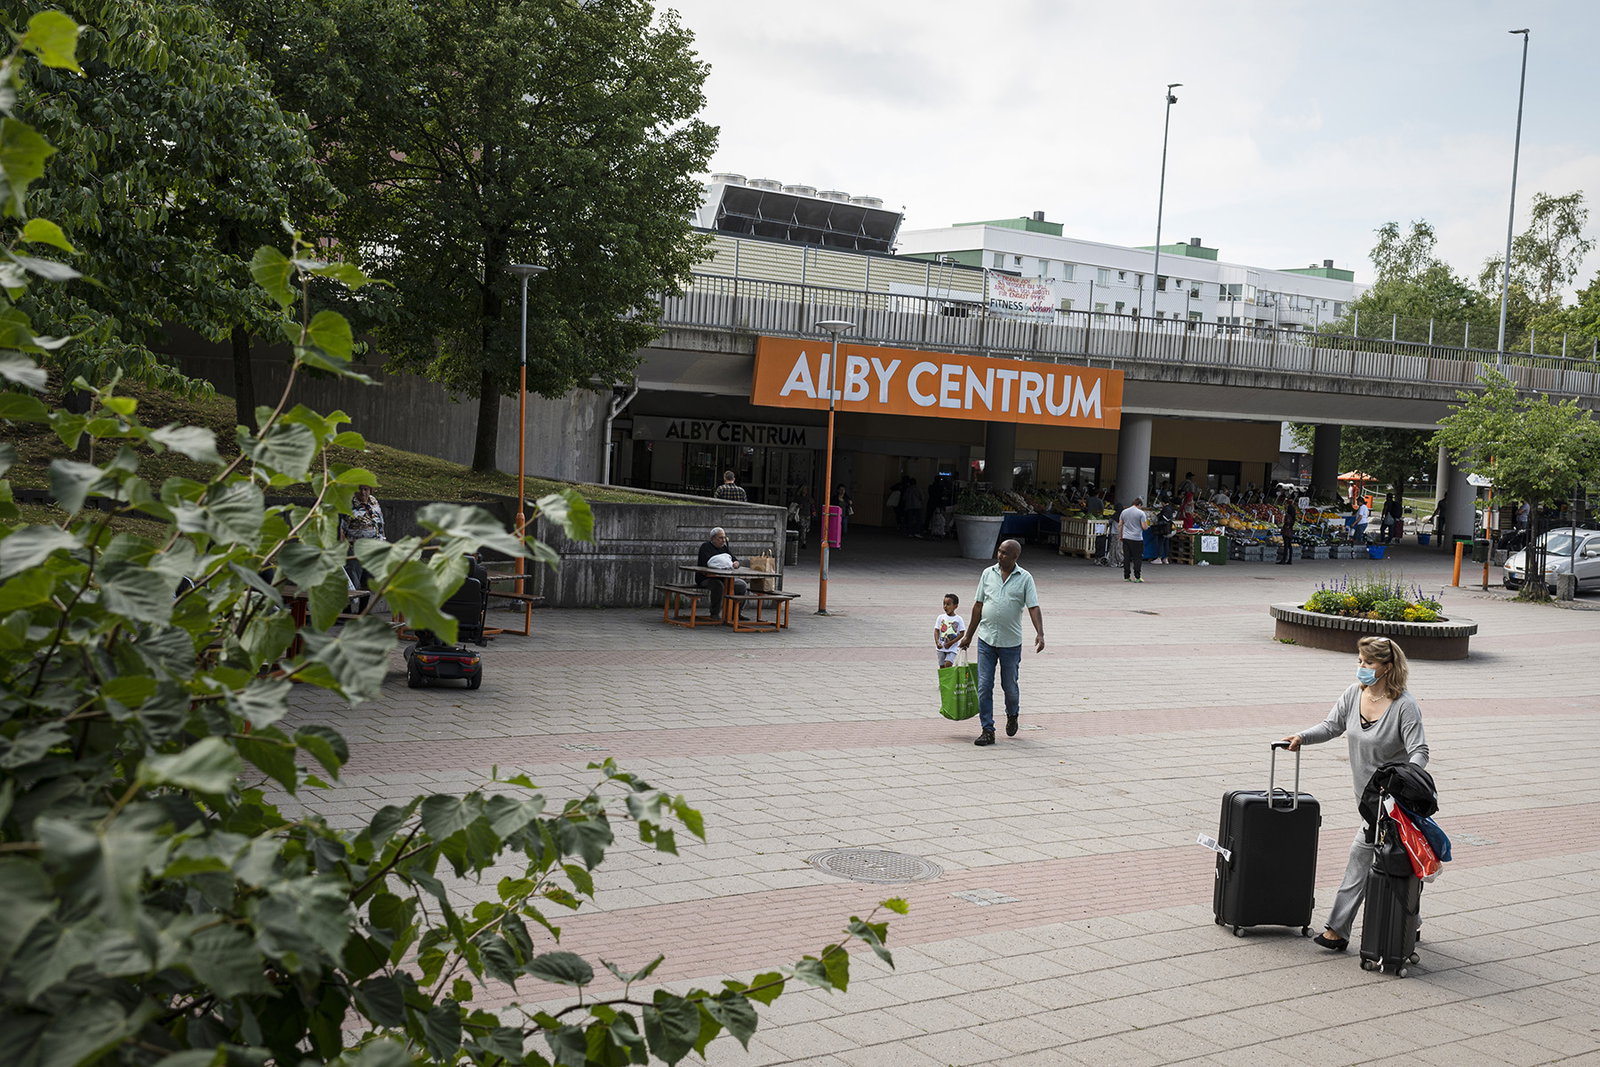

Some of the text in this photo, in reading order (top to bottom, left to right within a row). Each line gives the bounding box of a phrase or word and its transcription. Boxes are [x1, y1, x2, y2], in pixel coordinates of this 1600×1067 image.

[990, 298, 1024, 311] FITNESS
[779, 350, 1102, 419] ALBY CENTRUM
[665, 420, 807, 446] ALBY CENTRUM
